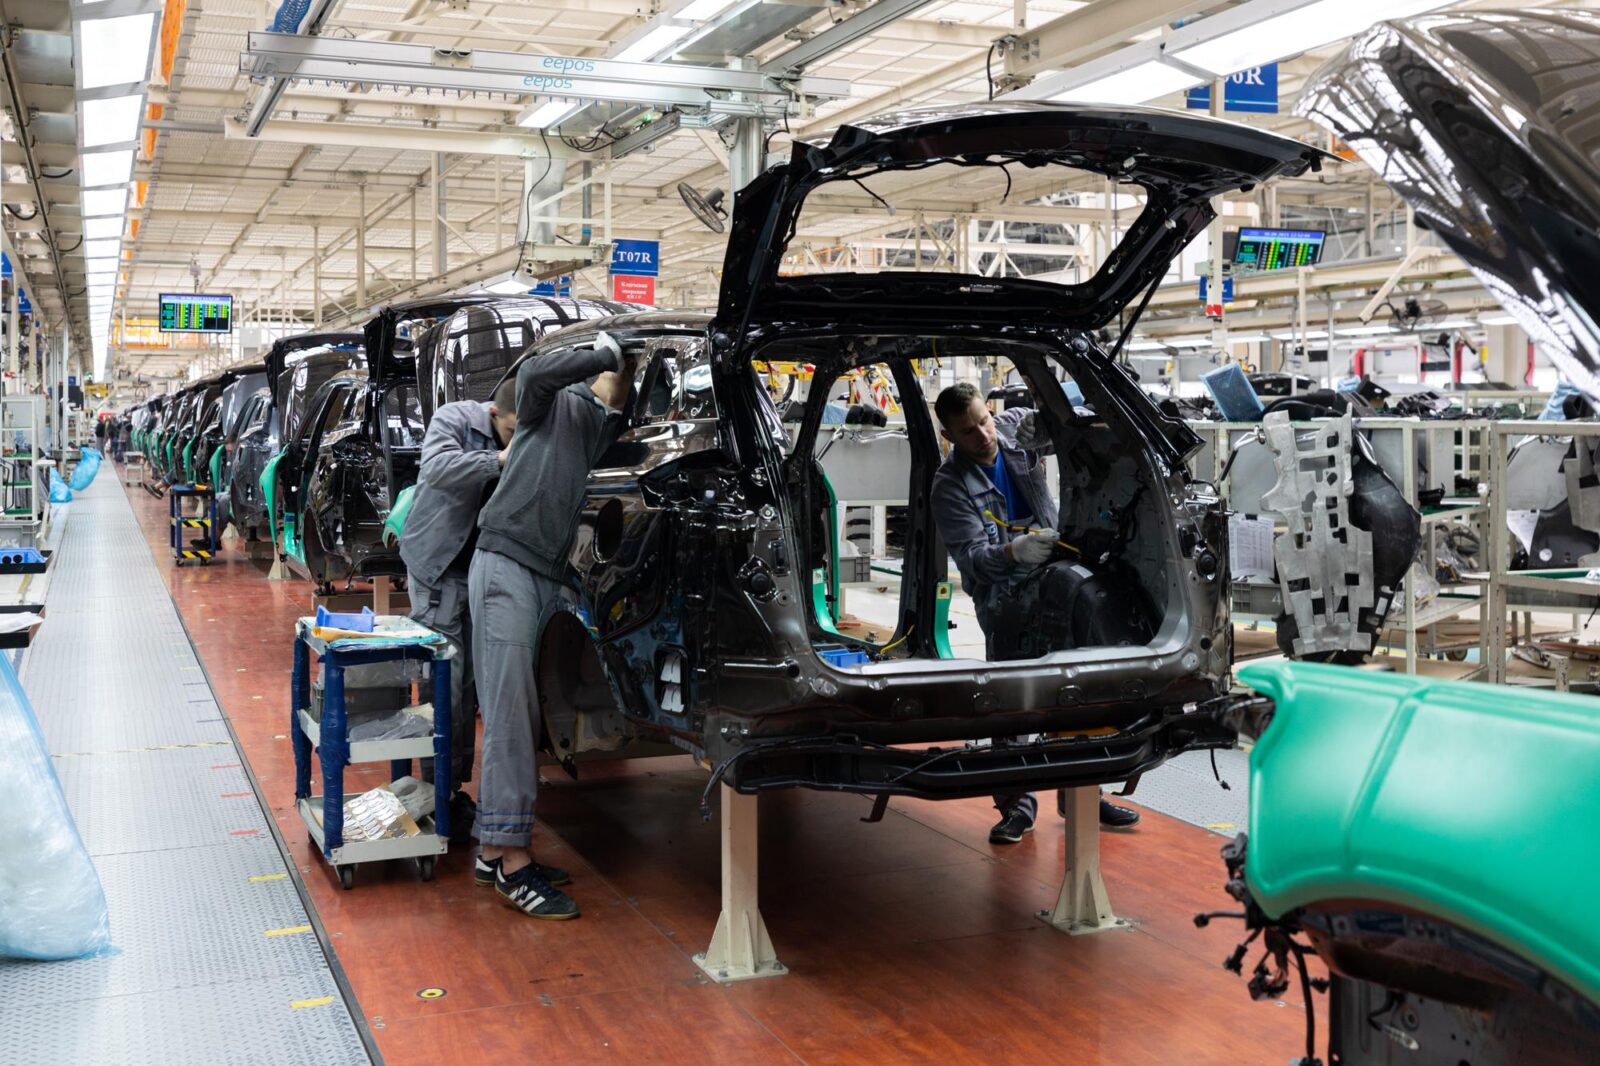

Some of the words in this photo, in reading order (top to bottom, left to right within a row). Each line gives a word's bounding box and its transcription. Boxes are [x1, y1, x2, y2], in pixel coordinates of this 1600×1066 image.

[543, 55, 595, 75] eepos
[523, 75, 573, 92] eepos
[617, 251, 652, 263] T07R
